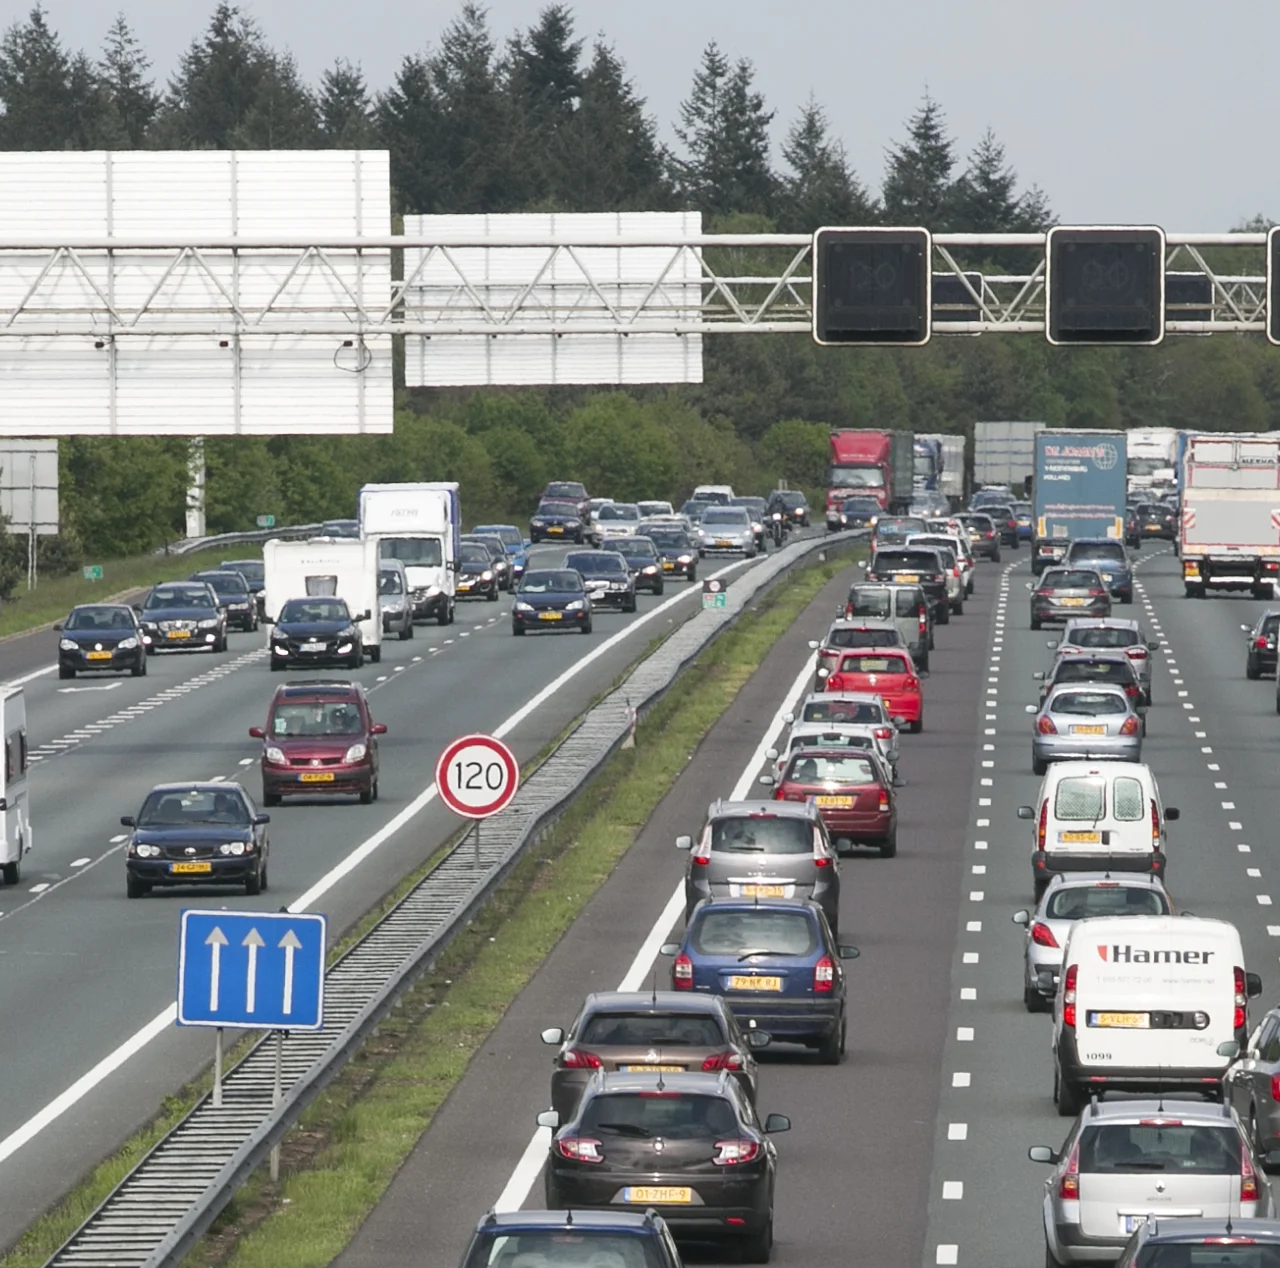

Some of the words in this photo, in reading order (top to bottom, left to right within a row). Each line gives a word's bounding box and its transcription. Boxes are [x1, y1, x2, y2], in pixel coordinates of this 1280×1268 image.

[455, 762, 504, 791] 120
[1111, 945, 1215, 964] Hamer
[636, 1189, 687, 1200] 01-ZHF-9
